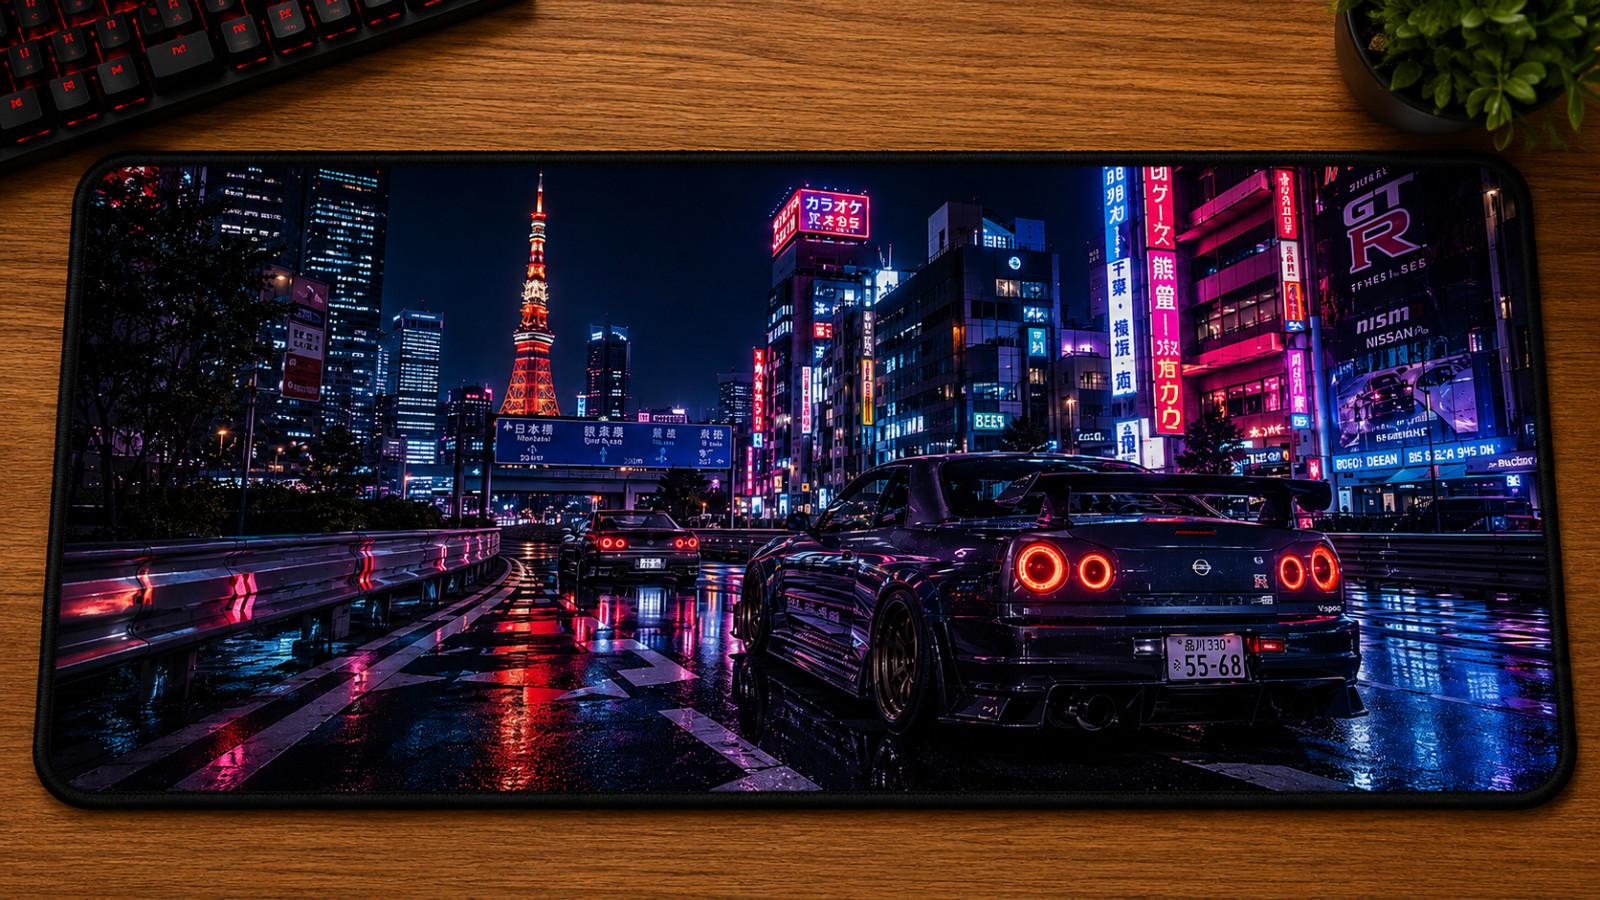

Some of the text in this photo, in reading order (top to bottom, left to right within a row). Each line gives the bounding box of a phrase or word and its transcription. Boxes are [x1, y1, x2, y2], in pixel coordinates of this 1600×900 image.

[806, 196, 862, 215] カラオケ
[1343, 172, 1414, 227] GT
[1347, 208, 1421, 275] R
[1366, 326, 1413, 349] NISSAN
[1207, 639, 1226, 651] 330
[1185, 654, 1241, 677] 55-68
